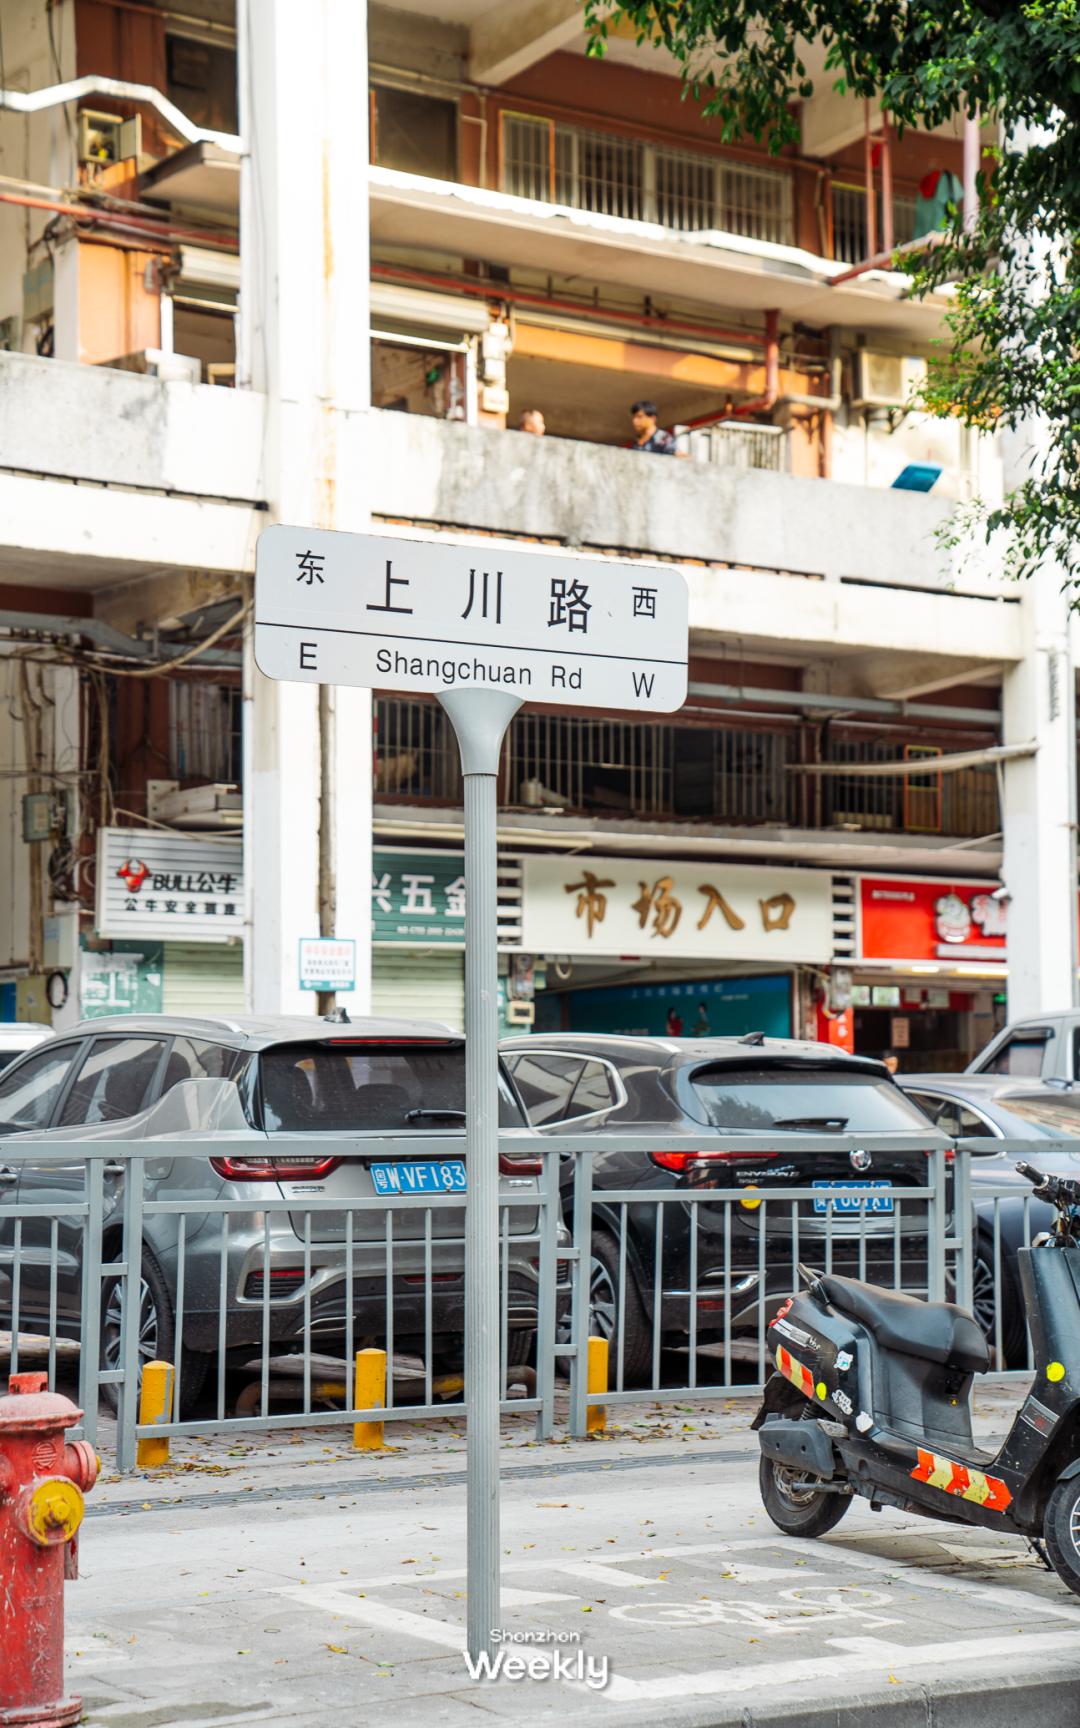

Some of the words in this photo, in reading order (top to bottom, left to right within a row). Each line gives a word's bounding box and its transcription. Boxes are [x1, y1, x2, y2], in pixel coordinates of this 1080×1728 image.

[296, 550, 325, 585] 东
[366, 560, 592, 634] 上川路
[632, 586, 658, 619] 西
[299, 642, 318, 670] E
[376, 649, 532, 685] Shangchuan
[551, 665, 582, 689] Rd
[632, 671, 655, 698] W
[564, 869, 796, 939] 市场入口
